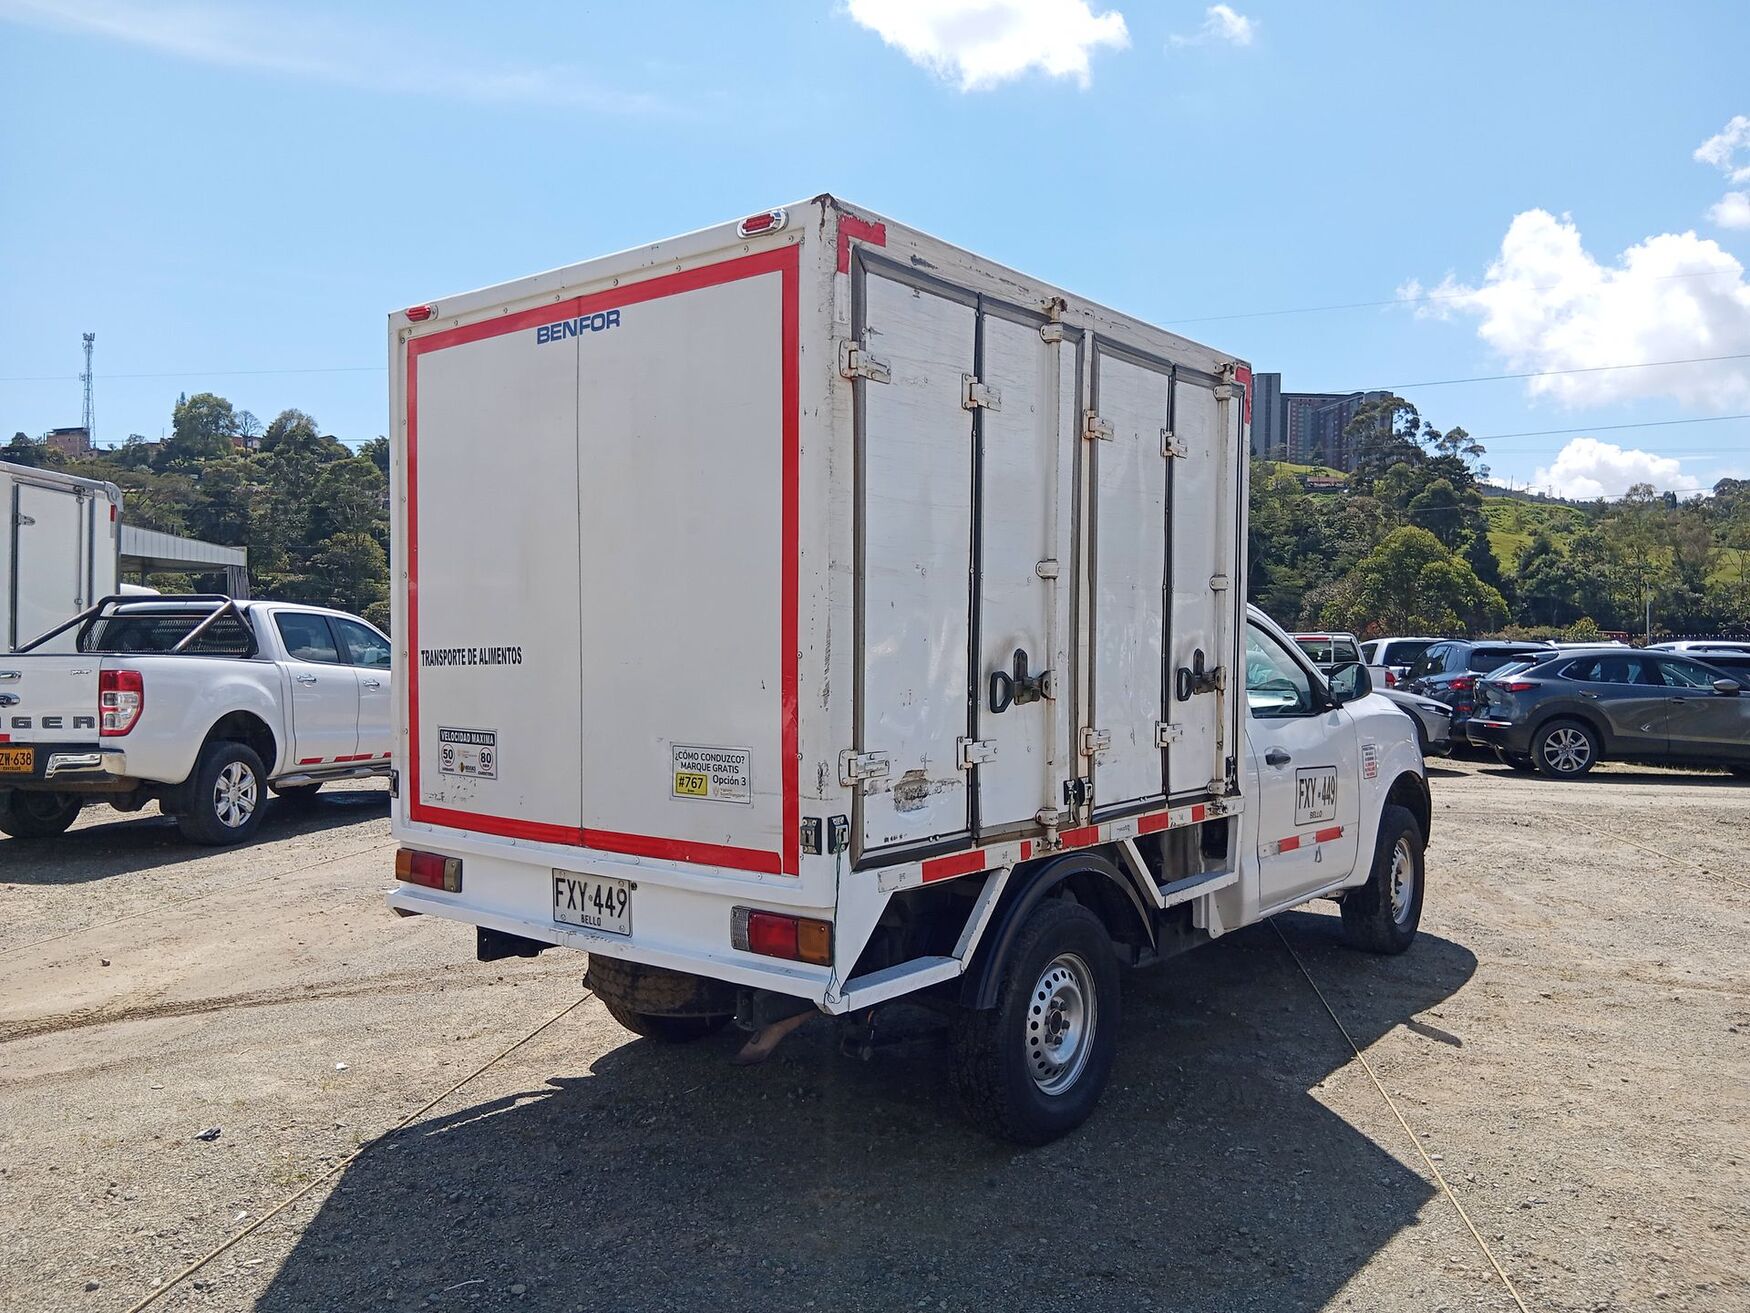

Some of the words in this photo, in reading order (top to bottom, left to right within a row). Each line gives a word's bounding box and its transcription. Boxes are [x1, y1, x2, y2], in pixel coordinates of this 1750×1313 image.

[537, 309, 620, 345] BENFOR
[421, 648, 466, 667] TRANSPORTE
[467, 648, 477, 665] DE
[479, 646, 522, 665] ALIMENTOS
[0, 716, 95, 729] GER
[440, 730, 471, 743] VELOCIDAD
[471, 732, 494, 745] MAXIMA
[443, 748, 453, 760] 50
[480, 752, 492, 764] 80
[700, 752, 745, 764] CONDUZCO?
[680, 761, 711, 772] MARQUE
[712, 764, 739, 774] GRATIS
[678, 775, 704, 790] #767
[712, 774, 739, 786] Opción
[741, 776, 747, 786] 3
[581, 914, 602, 927] BELLO
